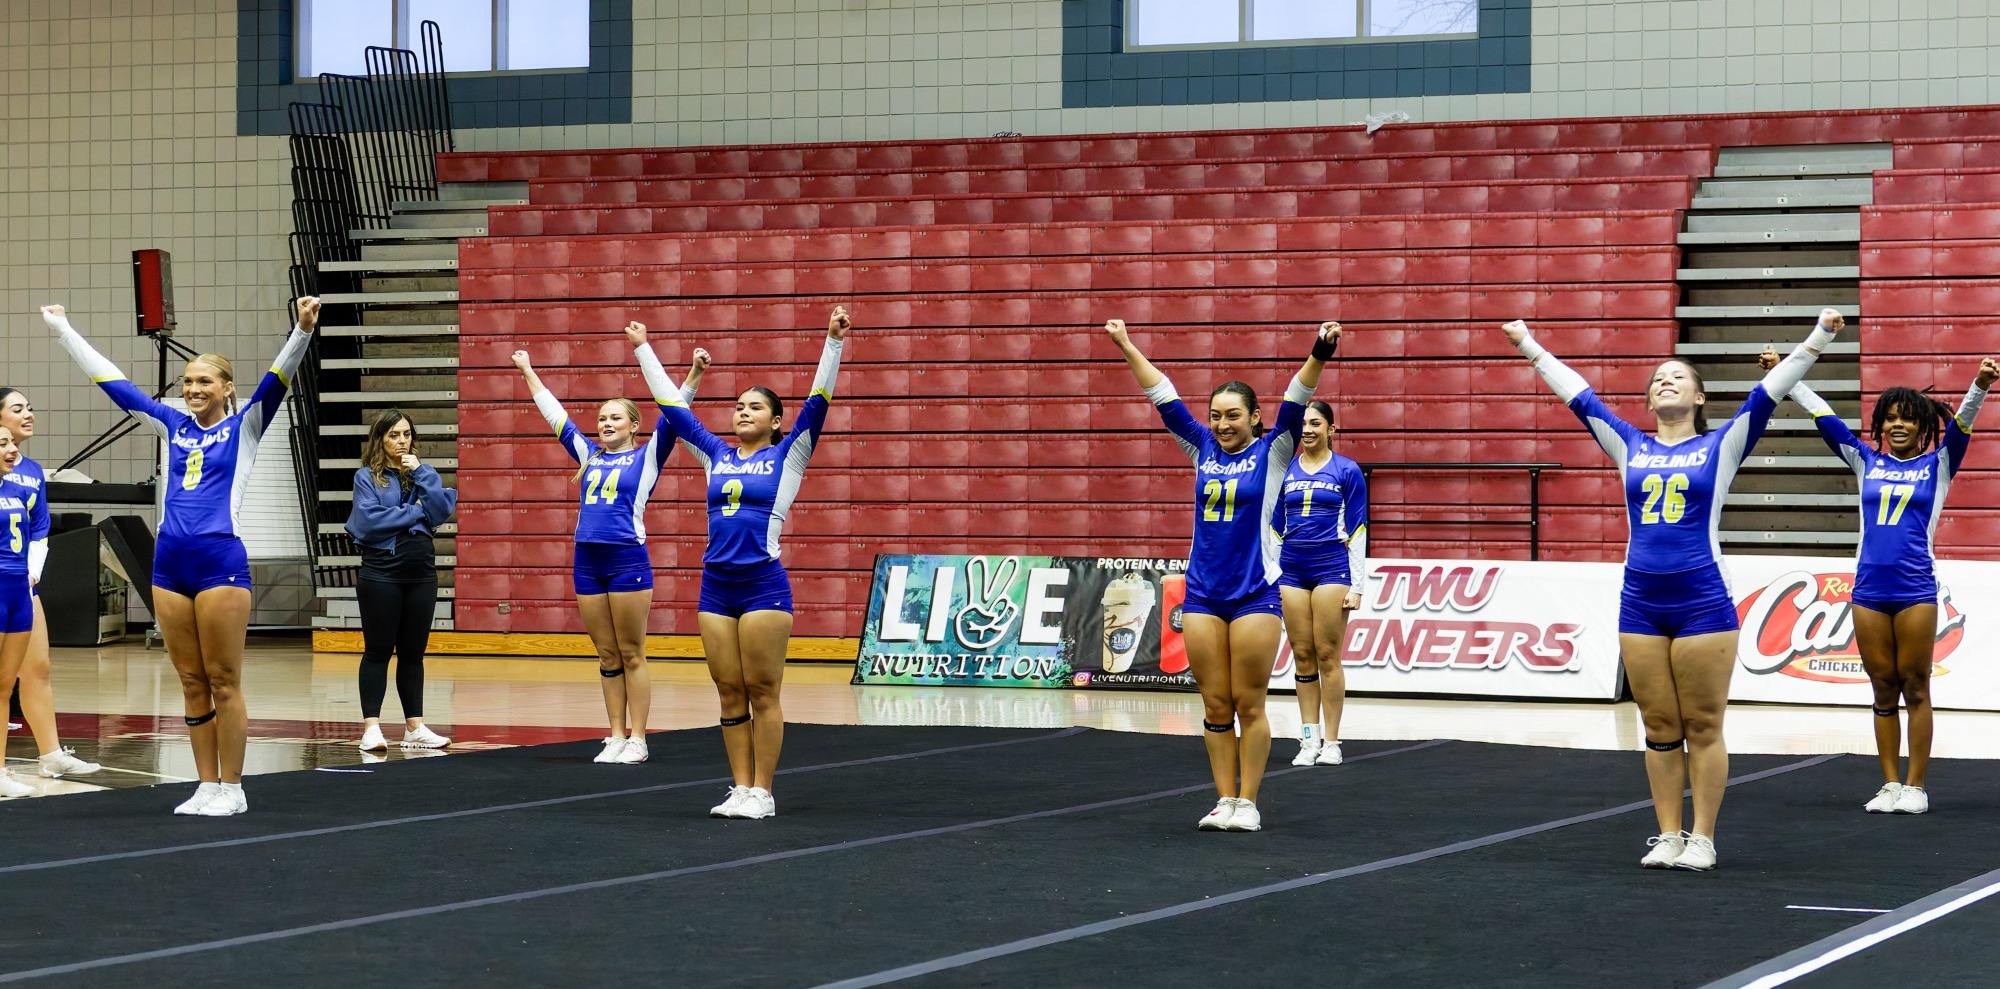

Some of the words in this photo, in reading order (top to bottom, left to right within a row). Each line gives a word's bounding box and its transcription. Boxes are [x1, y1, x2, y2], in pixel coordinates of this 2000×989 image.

[182, 448, 205, 491] 8
[1627, 446, 1708, 469] JAVELINAS
[585, 468, 622, 505] 24
[721, 478, 744, 517] 3
[1203, 478, 1238, 522] 21
[1300, 488, 1314, 517] 1
[1641, 472, 1690, 525] 26
[1876, 484, 1916, 526] 17
[9, 512, 23, 554] 5
[1096, 557, 1153, 570] PROTEIN
[1155, 559, 1166, 570] &
[1373, 566, 1501, 607] TWU
[1272, 619, 1582, 669] ONEERS
[870, 653, 1056, 680] NUTRITION
[1091, 674, 1191, 685] LIVENUTRITIONTX
